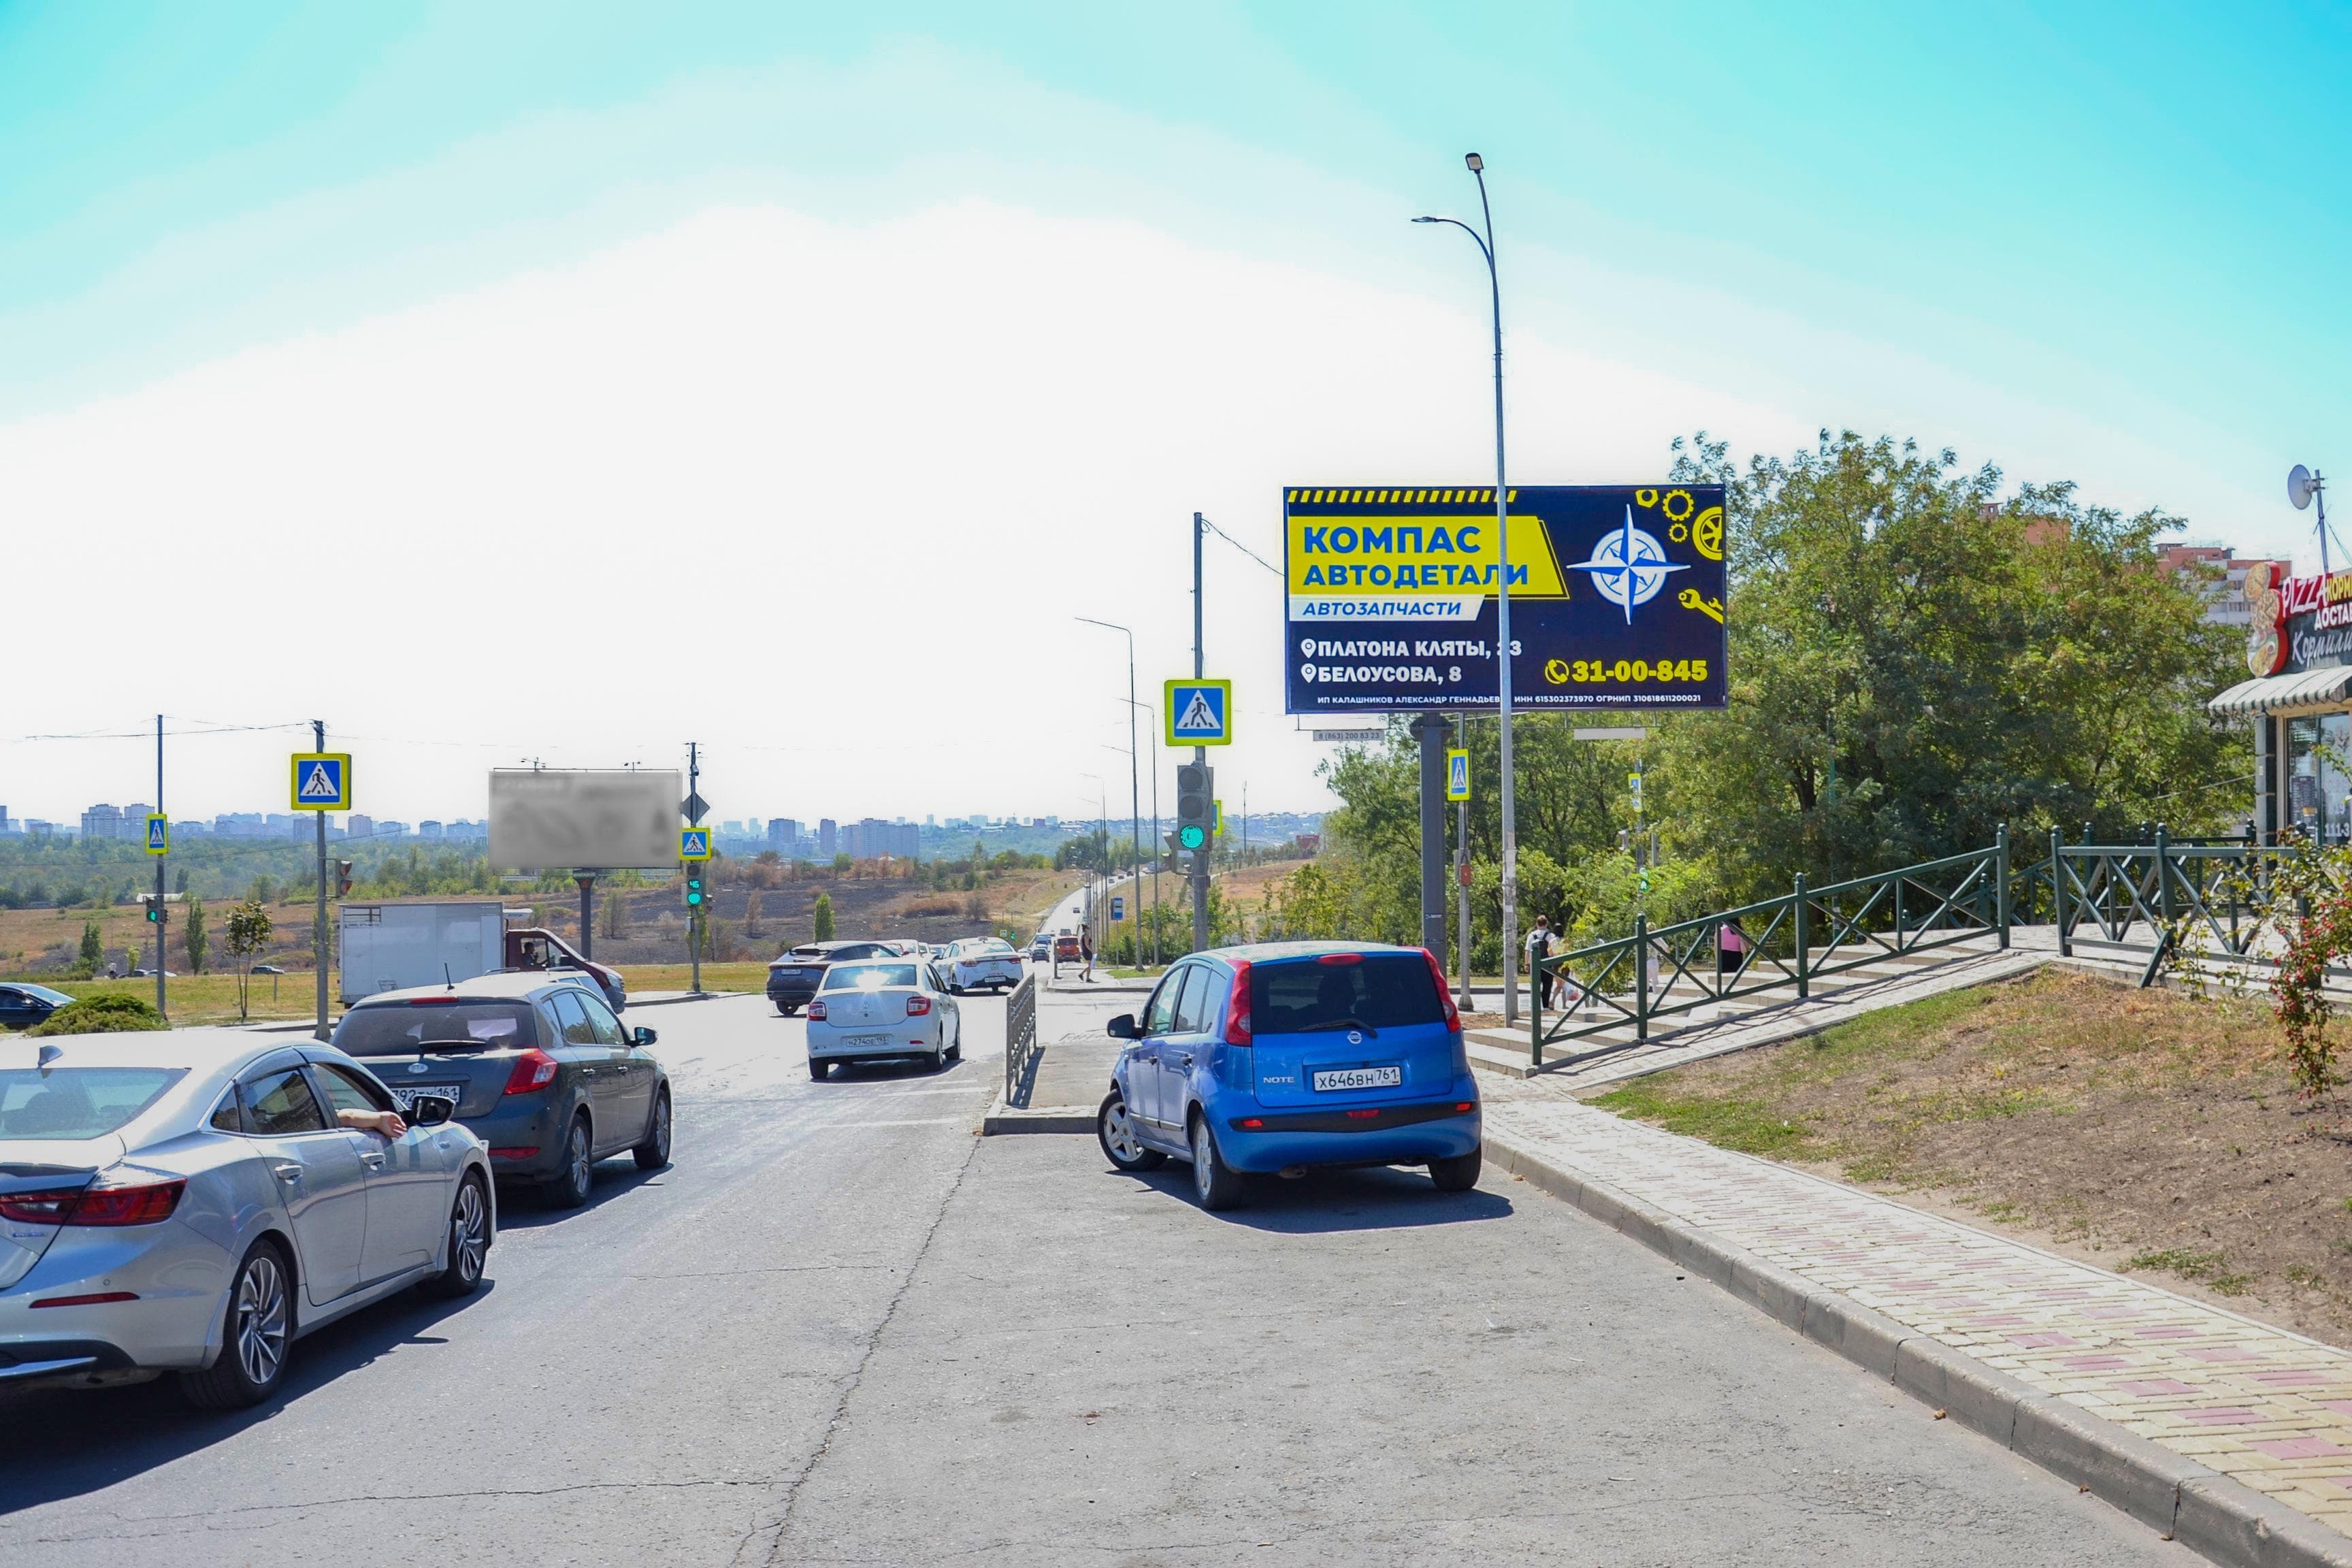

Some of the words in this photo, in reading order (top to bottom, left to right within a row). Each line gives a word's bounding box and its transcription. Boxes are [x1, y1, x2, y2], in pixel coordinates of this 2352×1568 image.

[1303, 526, 1481, 553] КОМПАС
[1303, 564, 1528, 589] АВТОДЕТАЛИ
[2282, 573, 2328, 618] PIZZA
[2327, 574, 2352, 602] КОРМ
[1303, 602, 1462, 616] АВТОЗАПЧАСТИ
[1318, 641, 1409, 656] ПЛАТОНА
[1415, 640, 1491, 659] КЛЯТЫ,
[1497, 640, 1522, 656] 3
[1318, 666, 1444, 685] БЕЛОУСОВА,
[1449, 666, 1462, 682] 8
[1571, 659, 1708, 681] 31-00-845
[1395, 696, 1447, 704] АЛЕКСАНДР
[1449, 696, 1501, 704] ГЕННАДЬЕВ
[1325, 732, 1344, 740] (863)
[1375, 1068, 1396, 1080] 761
